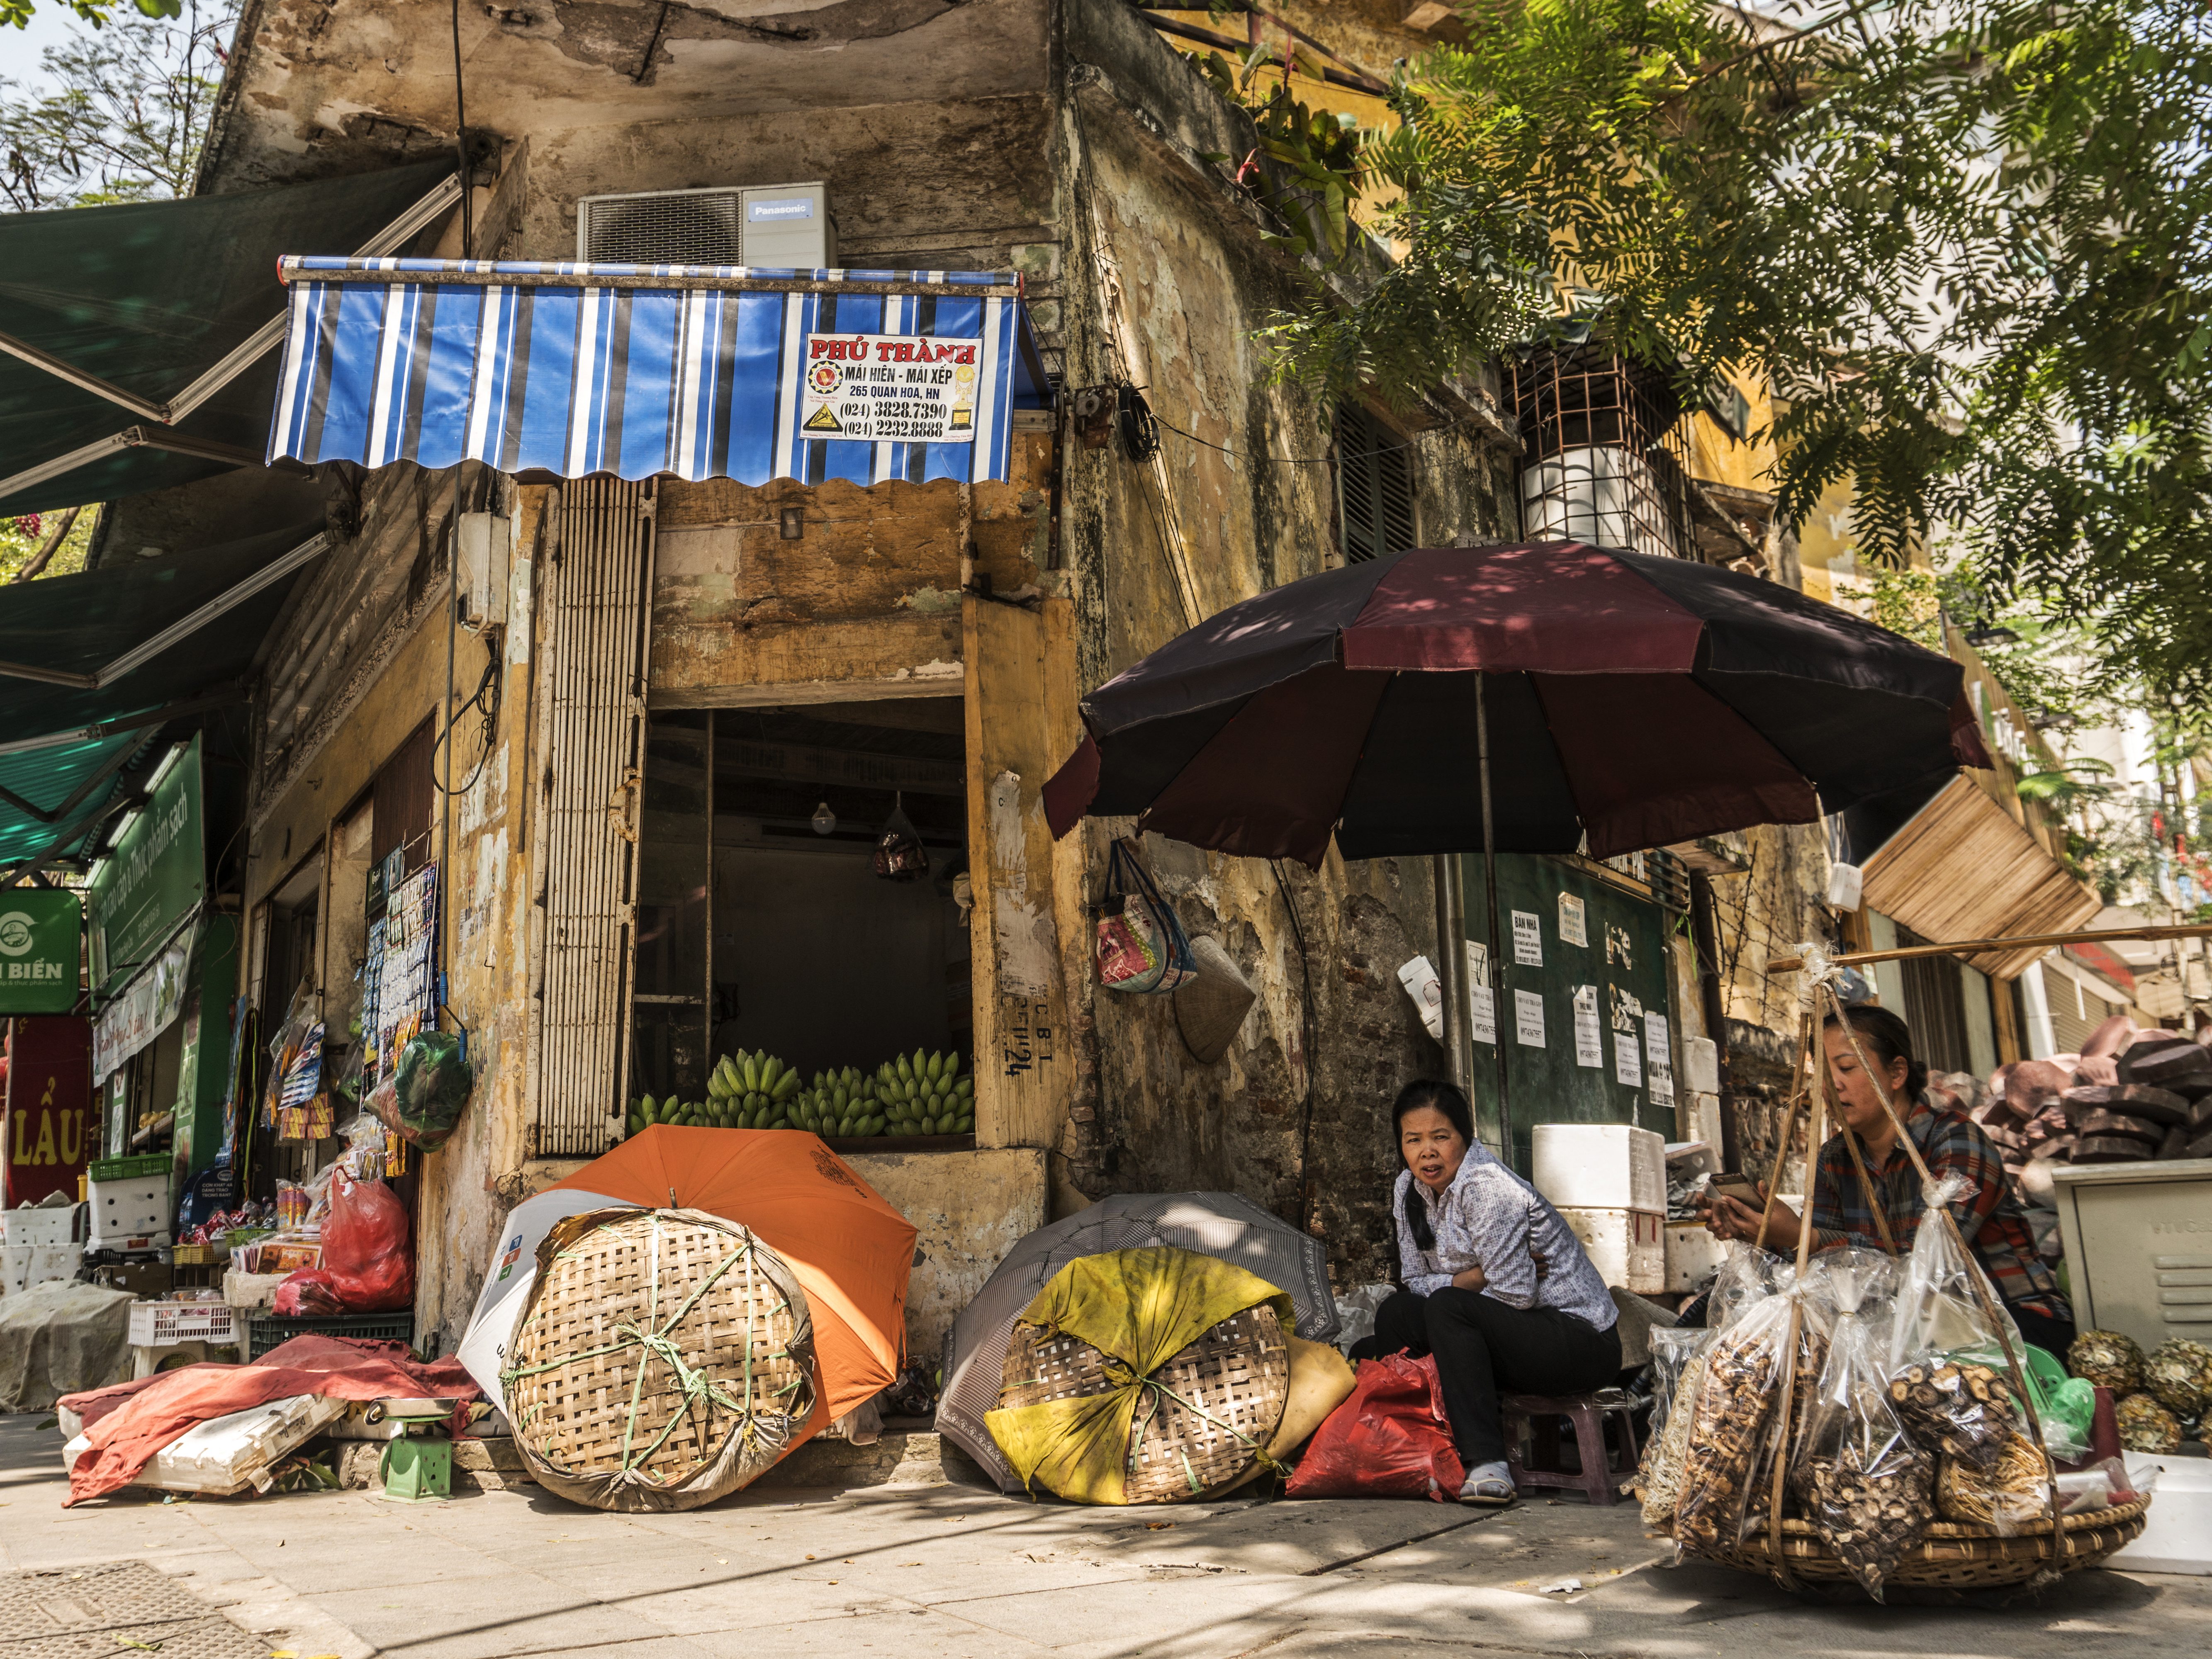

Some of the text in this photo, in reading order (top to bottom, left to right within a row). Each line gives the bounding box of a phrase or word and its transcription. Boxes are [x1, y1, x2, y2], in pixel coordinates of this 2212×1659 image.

[755, 204, 806, 215] Panasonic
[810, 336, 976, 364] PHÚ THÀNH
[845, 364, 866, 381] MÁI
[869, 365, 896, 382] HIÊN
[906, 366, 927, 383] MÁI
[930, 364, 952, 384] XẾP
[849, 385, 940, 400] 265 QUAN HOA, HN
[840, 403, 870, 419] (024)
[874, 401, 947, 419] 3828.7390
[844, 420, 943, 438] (024) 2232.8888
[131, 842, 148, 888] Thực
[148, 807, 169, 878] phẩm
[169, 782, 187, 847] sạch
[1515, 915, 1537, 931] BÁN NHÀ
[1475, 1022, 1495, 1035] 097436755
[1648, 1060, 1658, 1078] MUA
[12, 1077, 83, 1166] LẨU
[501, 1236, 521, 1279] FPT
